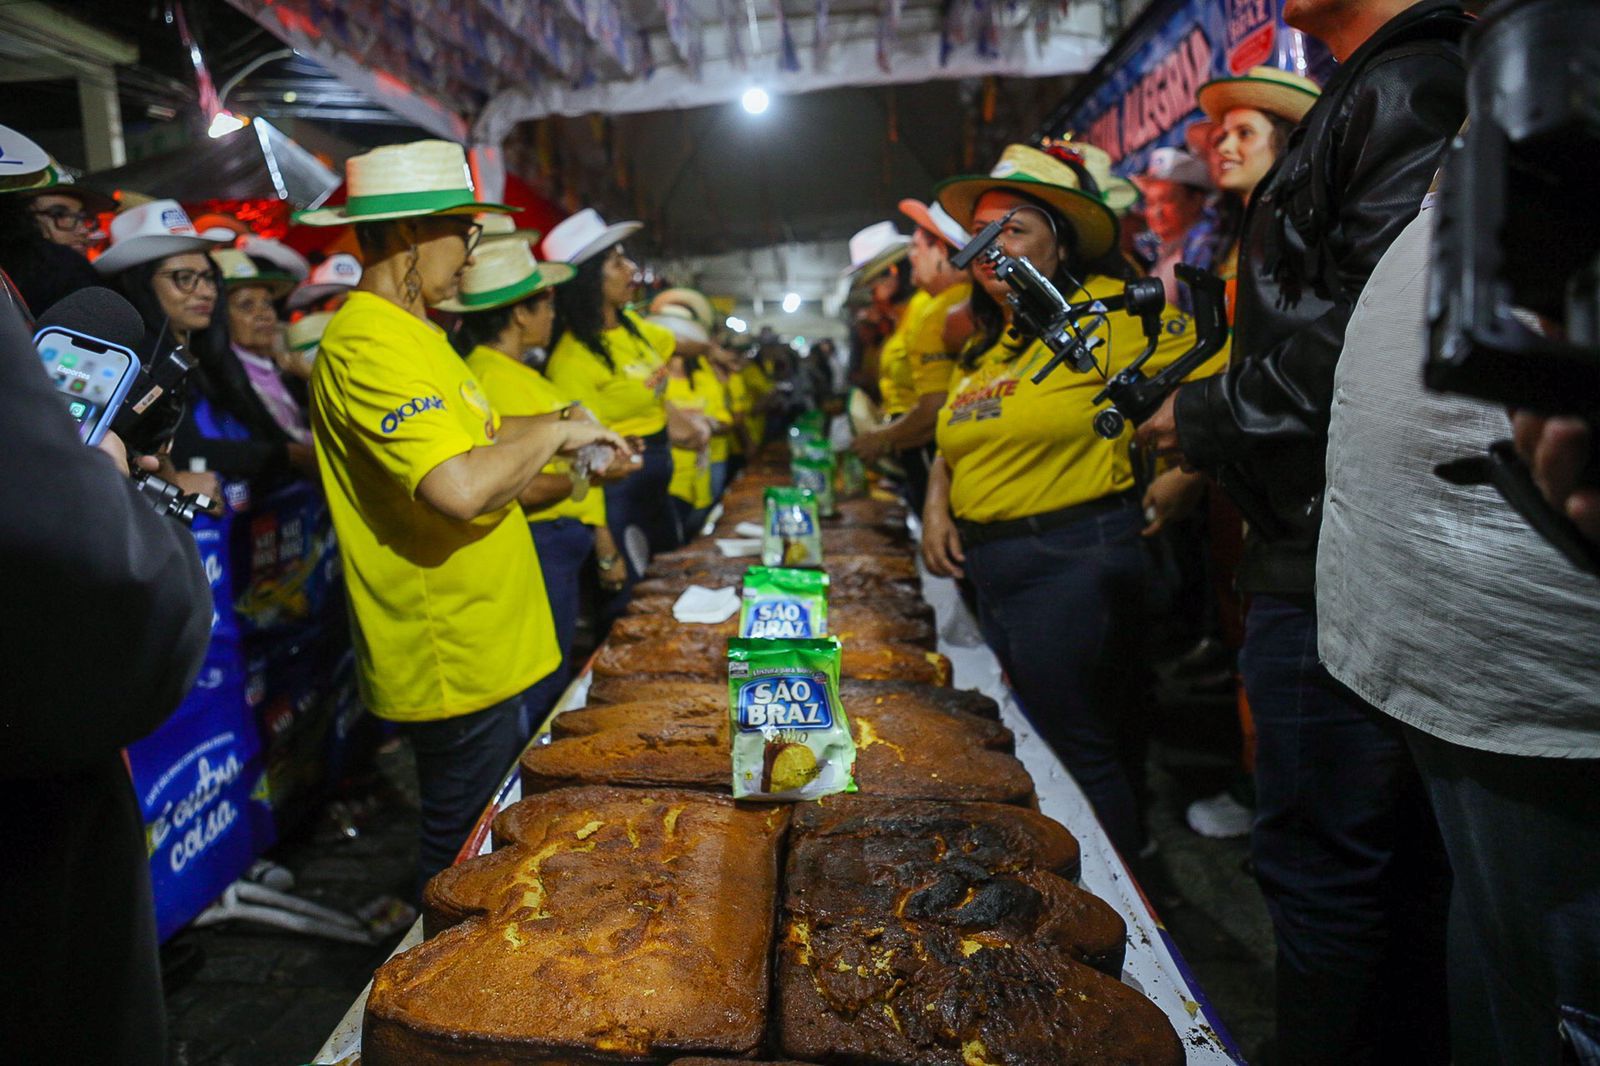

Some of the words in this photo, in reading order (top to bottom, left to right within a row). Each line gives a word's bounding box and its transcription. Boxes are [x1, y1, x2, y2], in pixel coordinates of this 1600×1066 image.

[57, 364, 91, 380] Esportes
[758, 601, 801, 621] SÃO
[751, 620, 805, 638] BRAZ
[753, 679, 812, 705] SÃO
[747, 702, 822, 726] BRAZ
[170, 799, 238, 872] coisa
